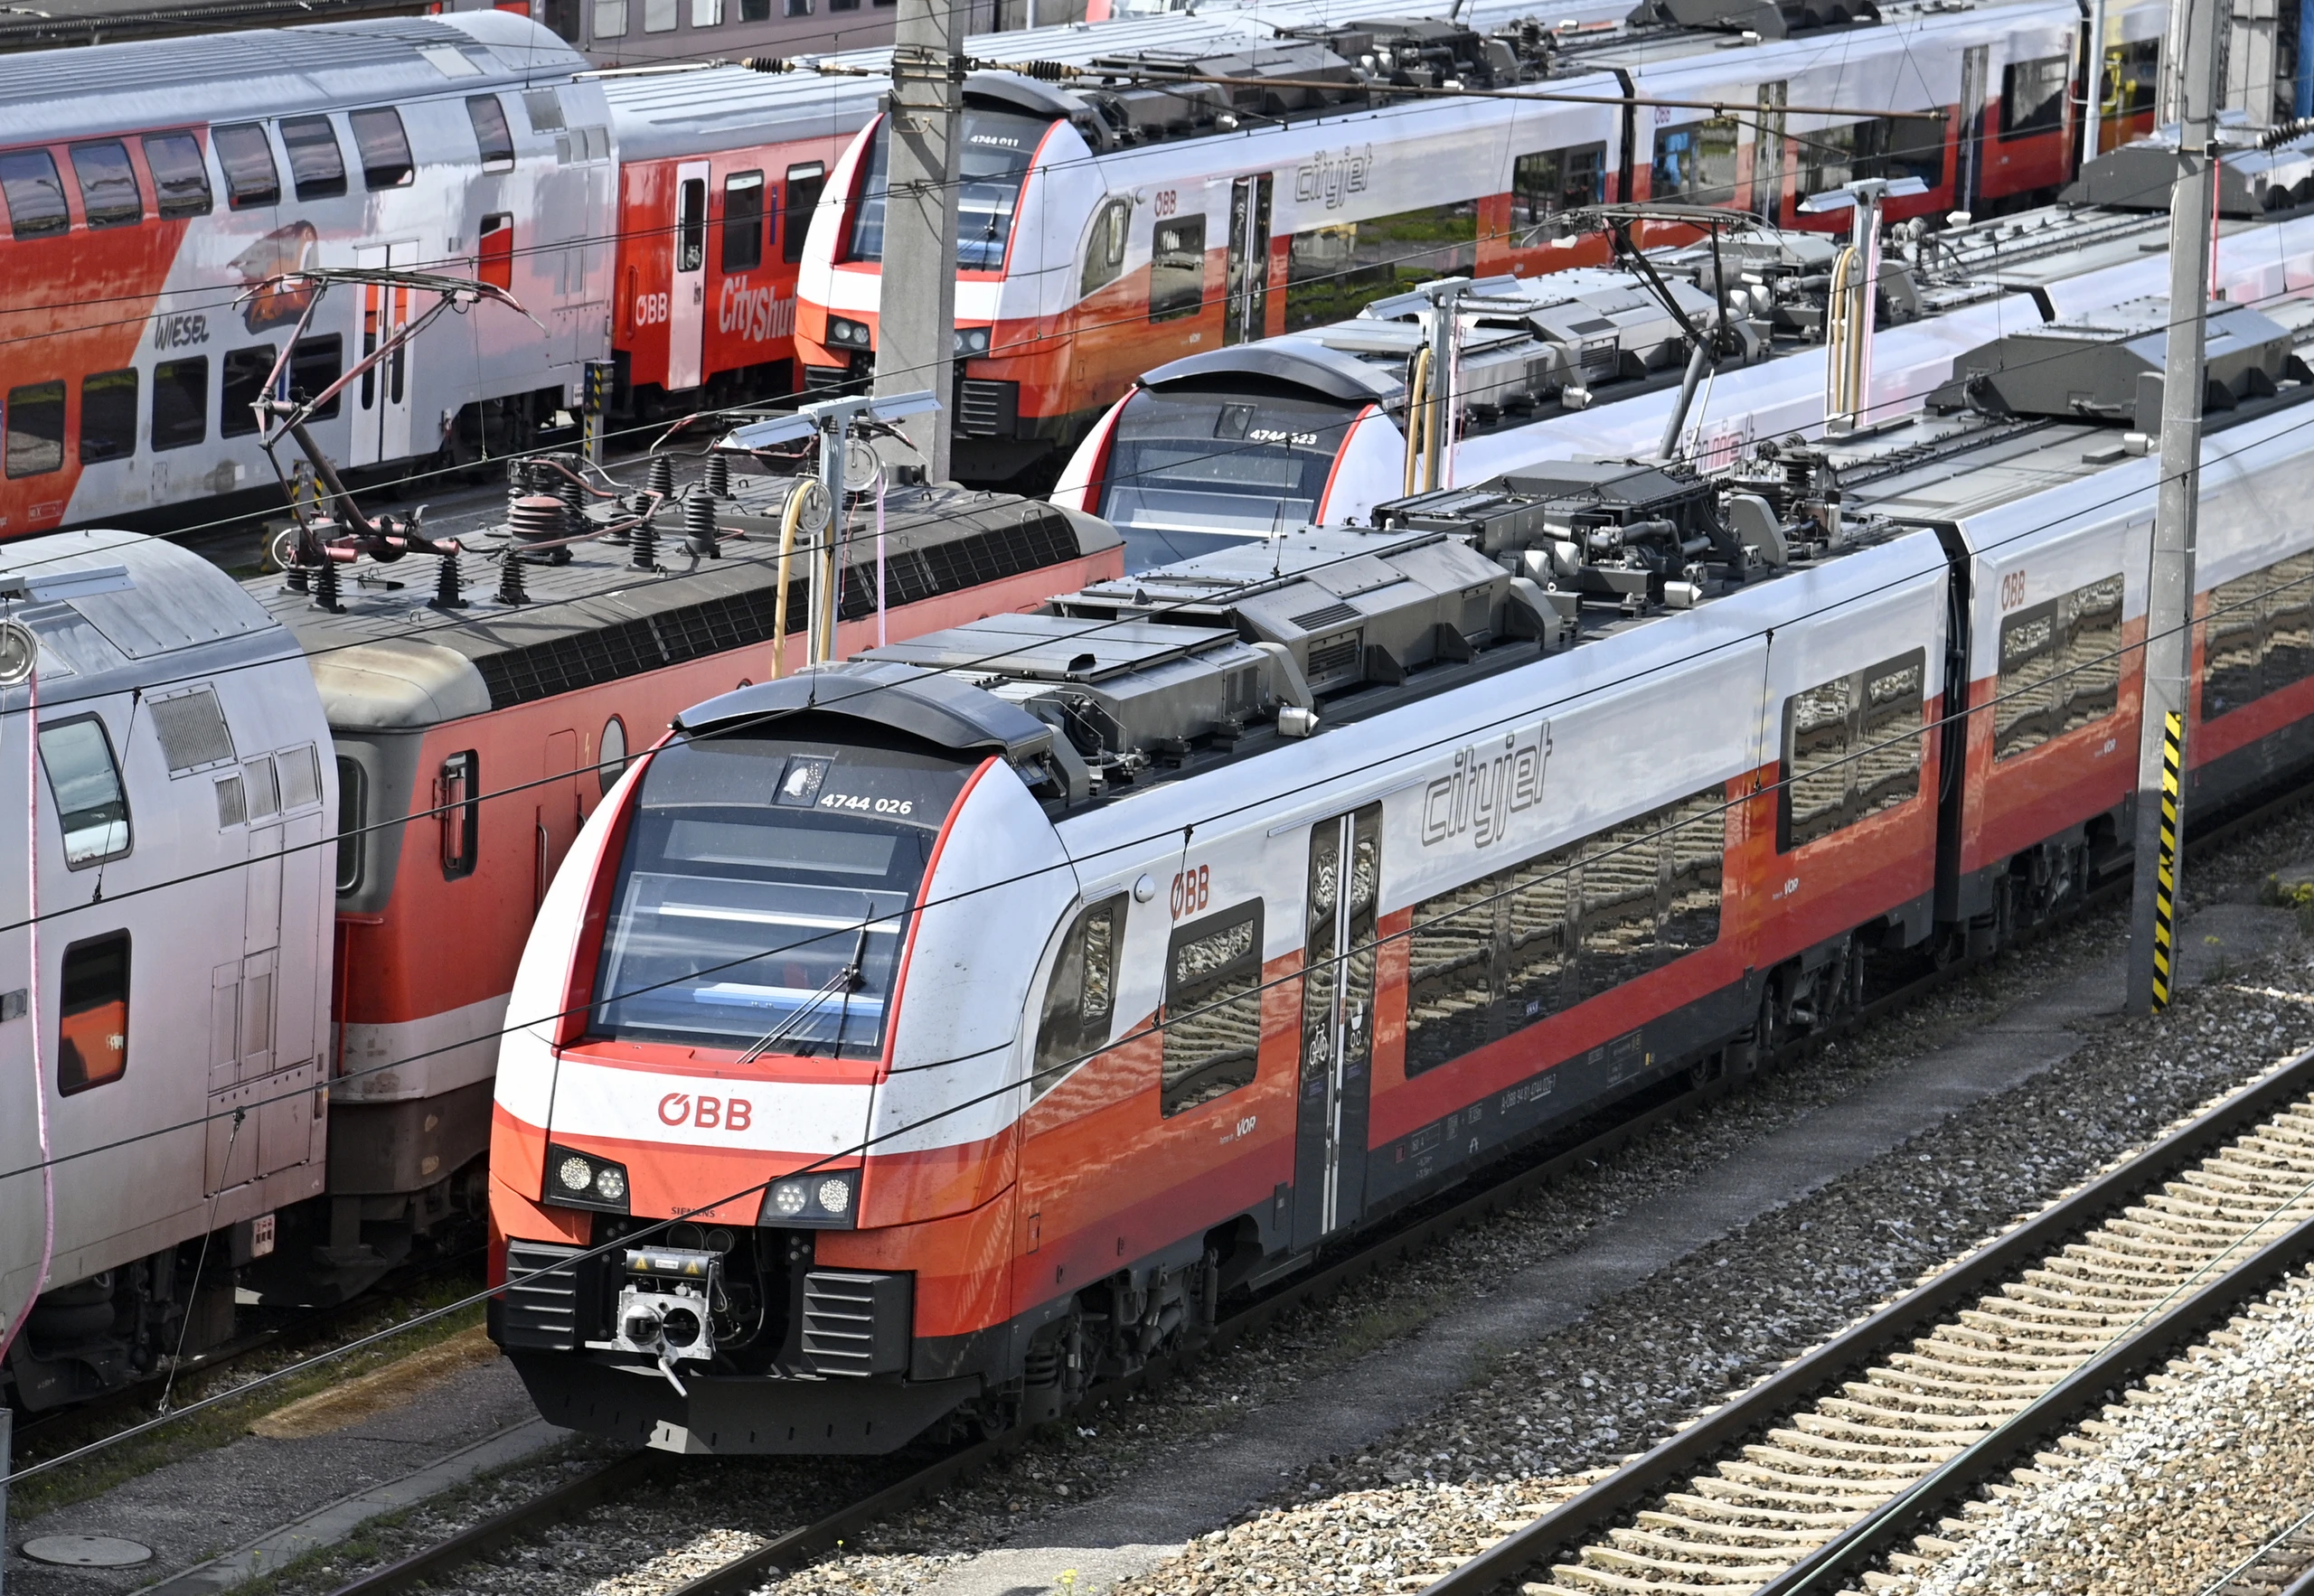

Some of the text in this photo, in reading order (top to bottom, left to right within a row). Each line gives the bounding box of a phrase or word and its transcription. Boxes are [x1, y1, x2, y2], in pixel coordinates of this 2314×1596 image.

[970, 135, 1019, 146] 4744 011
[1294, 142, 1372, 210] cityjet
[1154, 190, 1177, 217] ÖBB
[635, 292, 668, 326] ÖBB
[155, 315, 210, 352] WIESEL
[1249, 429, 1287, 442] 4744
[2001, 570, 2026, 612] ÖBB
[1422, 718, 1553, 849] cityjet
[820, 793, 913, 814] 4744 026
[1170, 864, 1209, 921] ÖBB
[1784, 877, 1799, 896] VOR
[658, 1092, 752, 1131] ÖBB
[1237, 1115, 1256, 1137] VOR
[671, 1206, 716, 1218] SIENS
